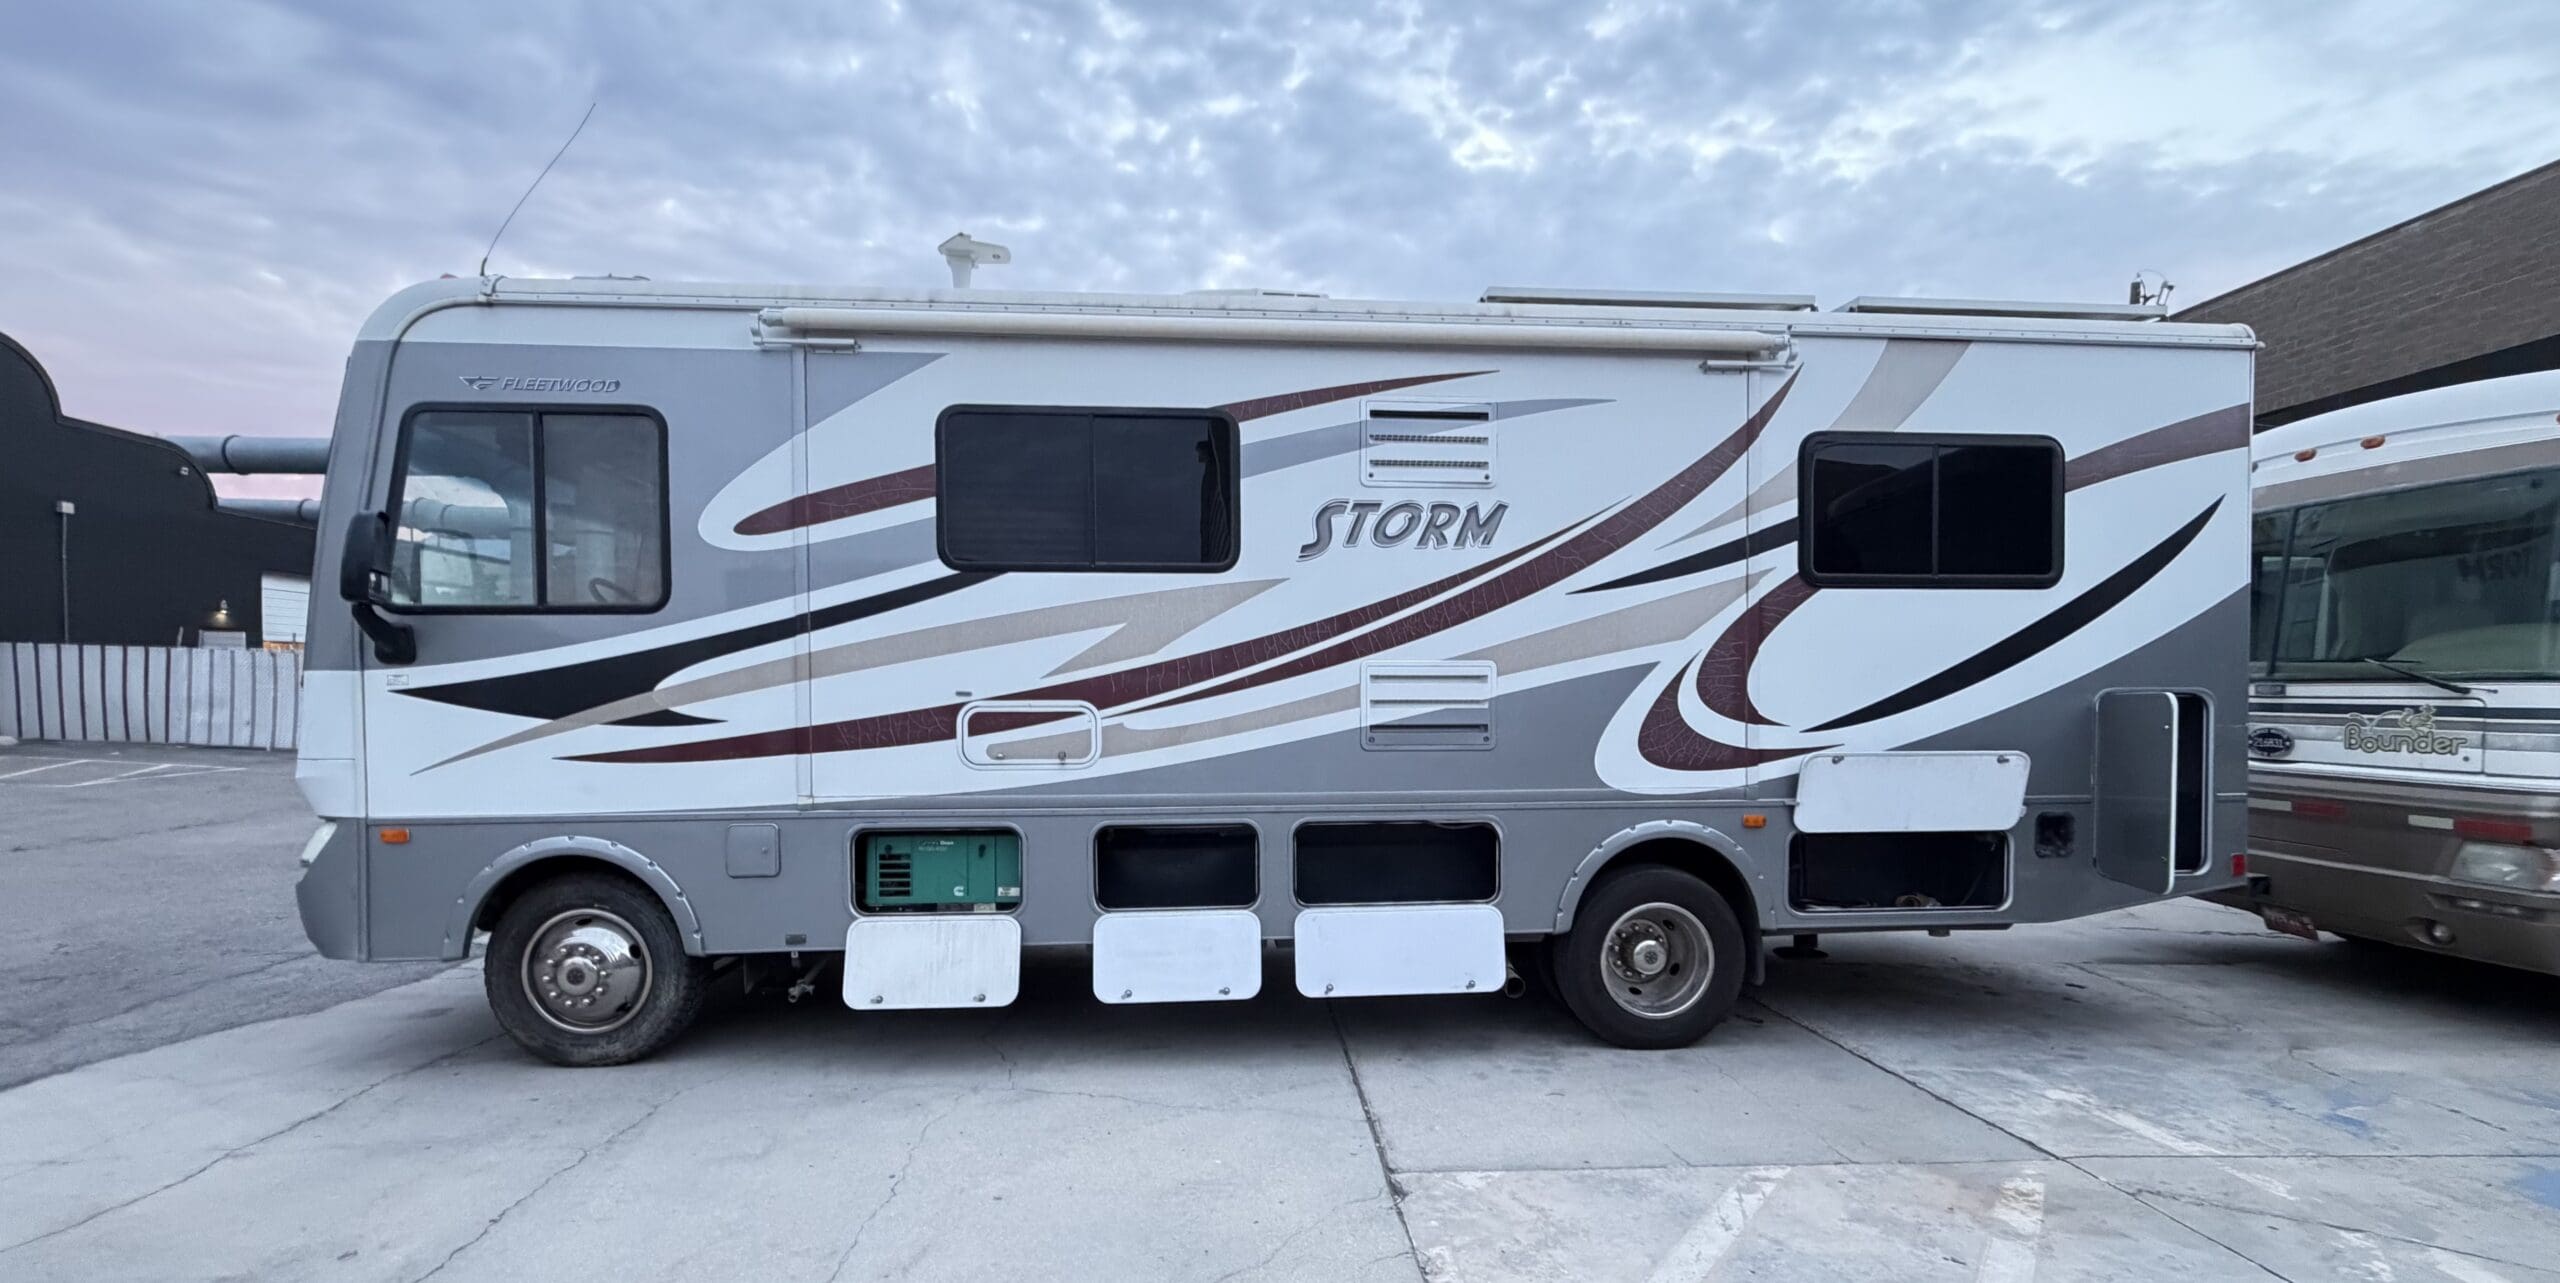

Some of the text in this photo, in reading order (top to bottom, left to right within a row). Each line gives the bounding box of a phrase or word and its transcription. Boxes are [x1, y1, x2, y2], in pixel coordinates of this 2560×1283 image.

[503, 376, 620, 393] FLEETWOOD
[1297, 499, 1508, 561] STORM
[2345, 725, 2468, 756] Bounder
